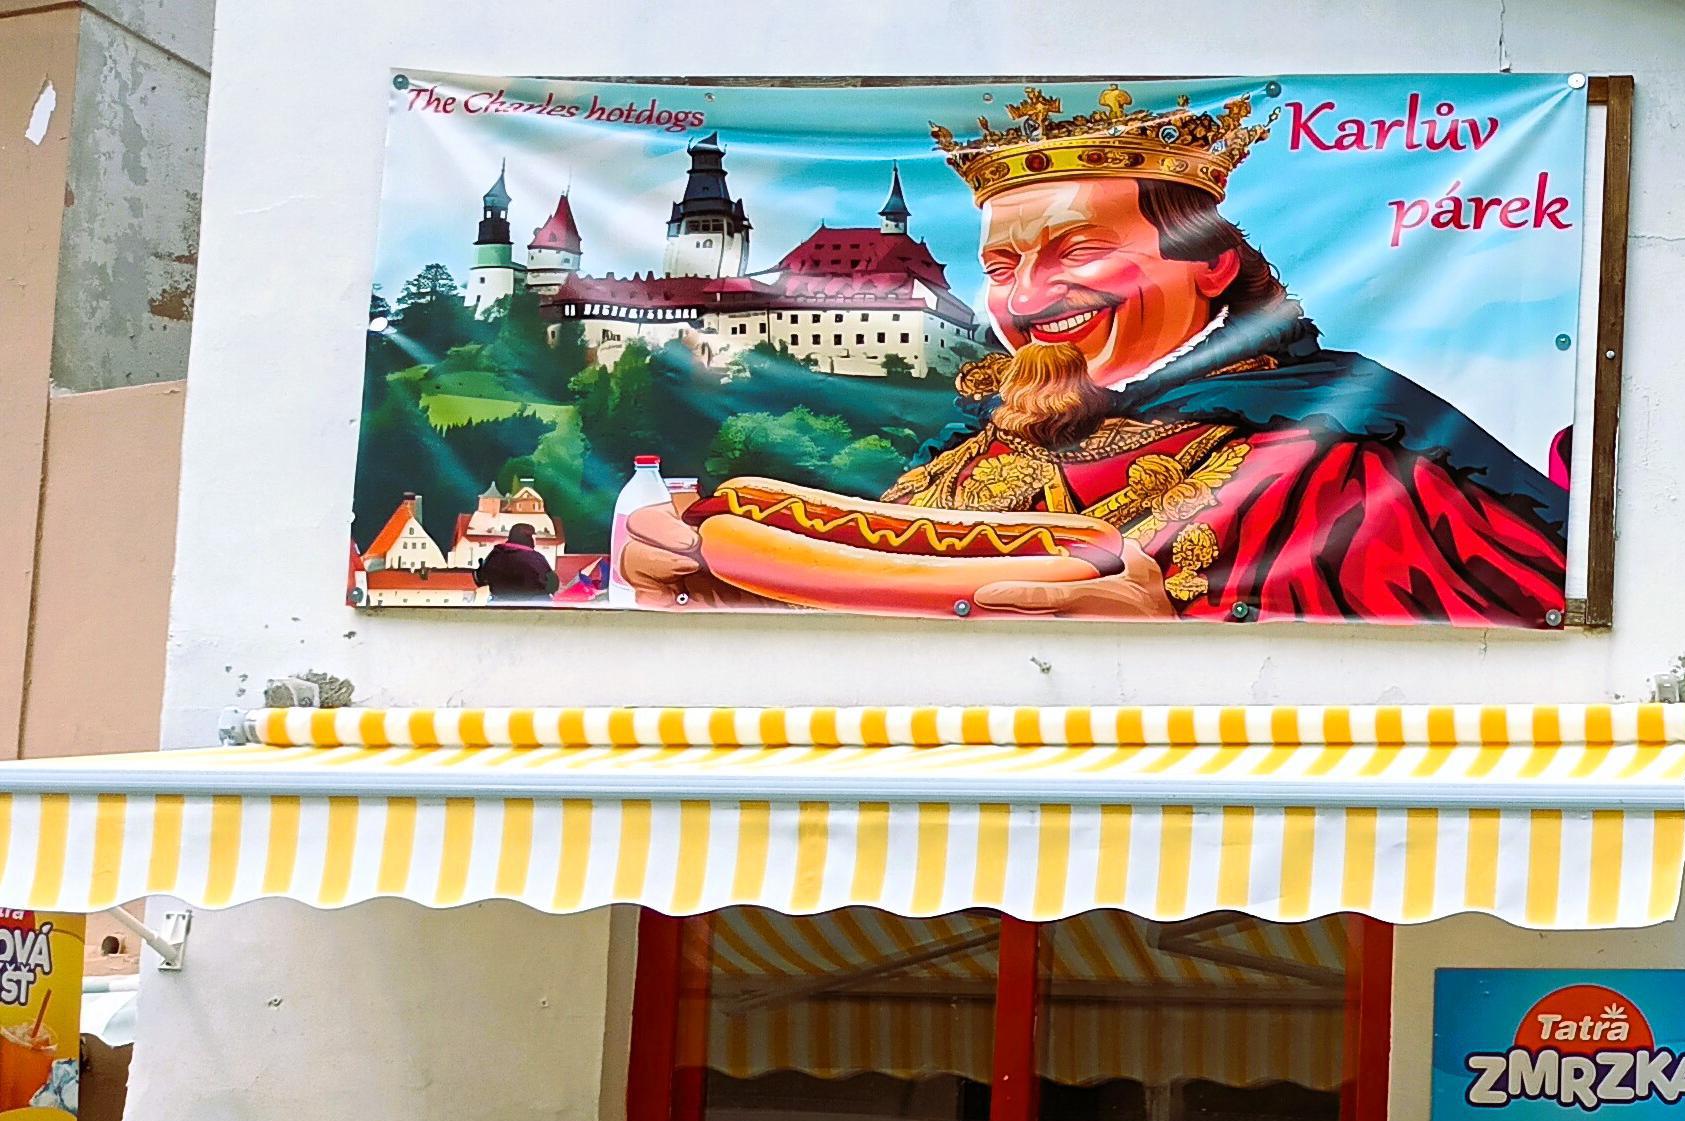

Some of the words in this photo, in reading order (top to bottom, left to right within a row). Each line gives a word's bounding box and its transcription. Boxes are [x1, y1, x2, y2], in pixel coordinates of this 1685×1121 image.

[408, 87, 455, 113] The
[463, 89, 579, 118] Charles
[584, 95, 705, 133] hotdogs
[1284, 92, 1499, 151] Karlův
[1388, 171, 1573, 247] párek
[1537, 1013, 1630, 1042] Tatra
